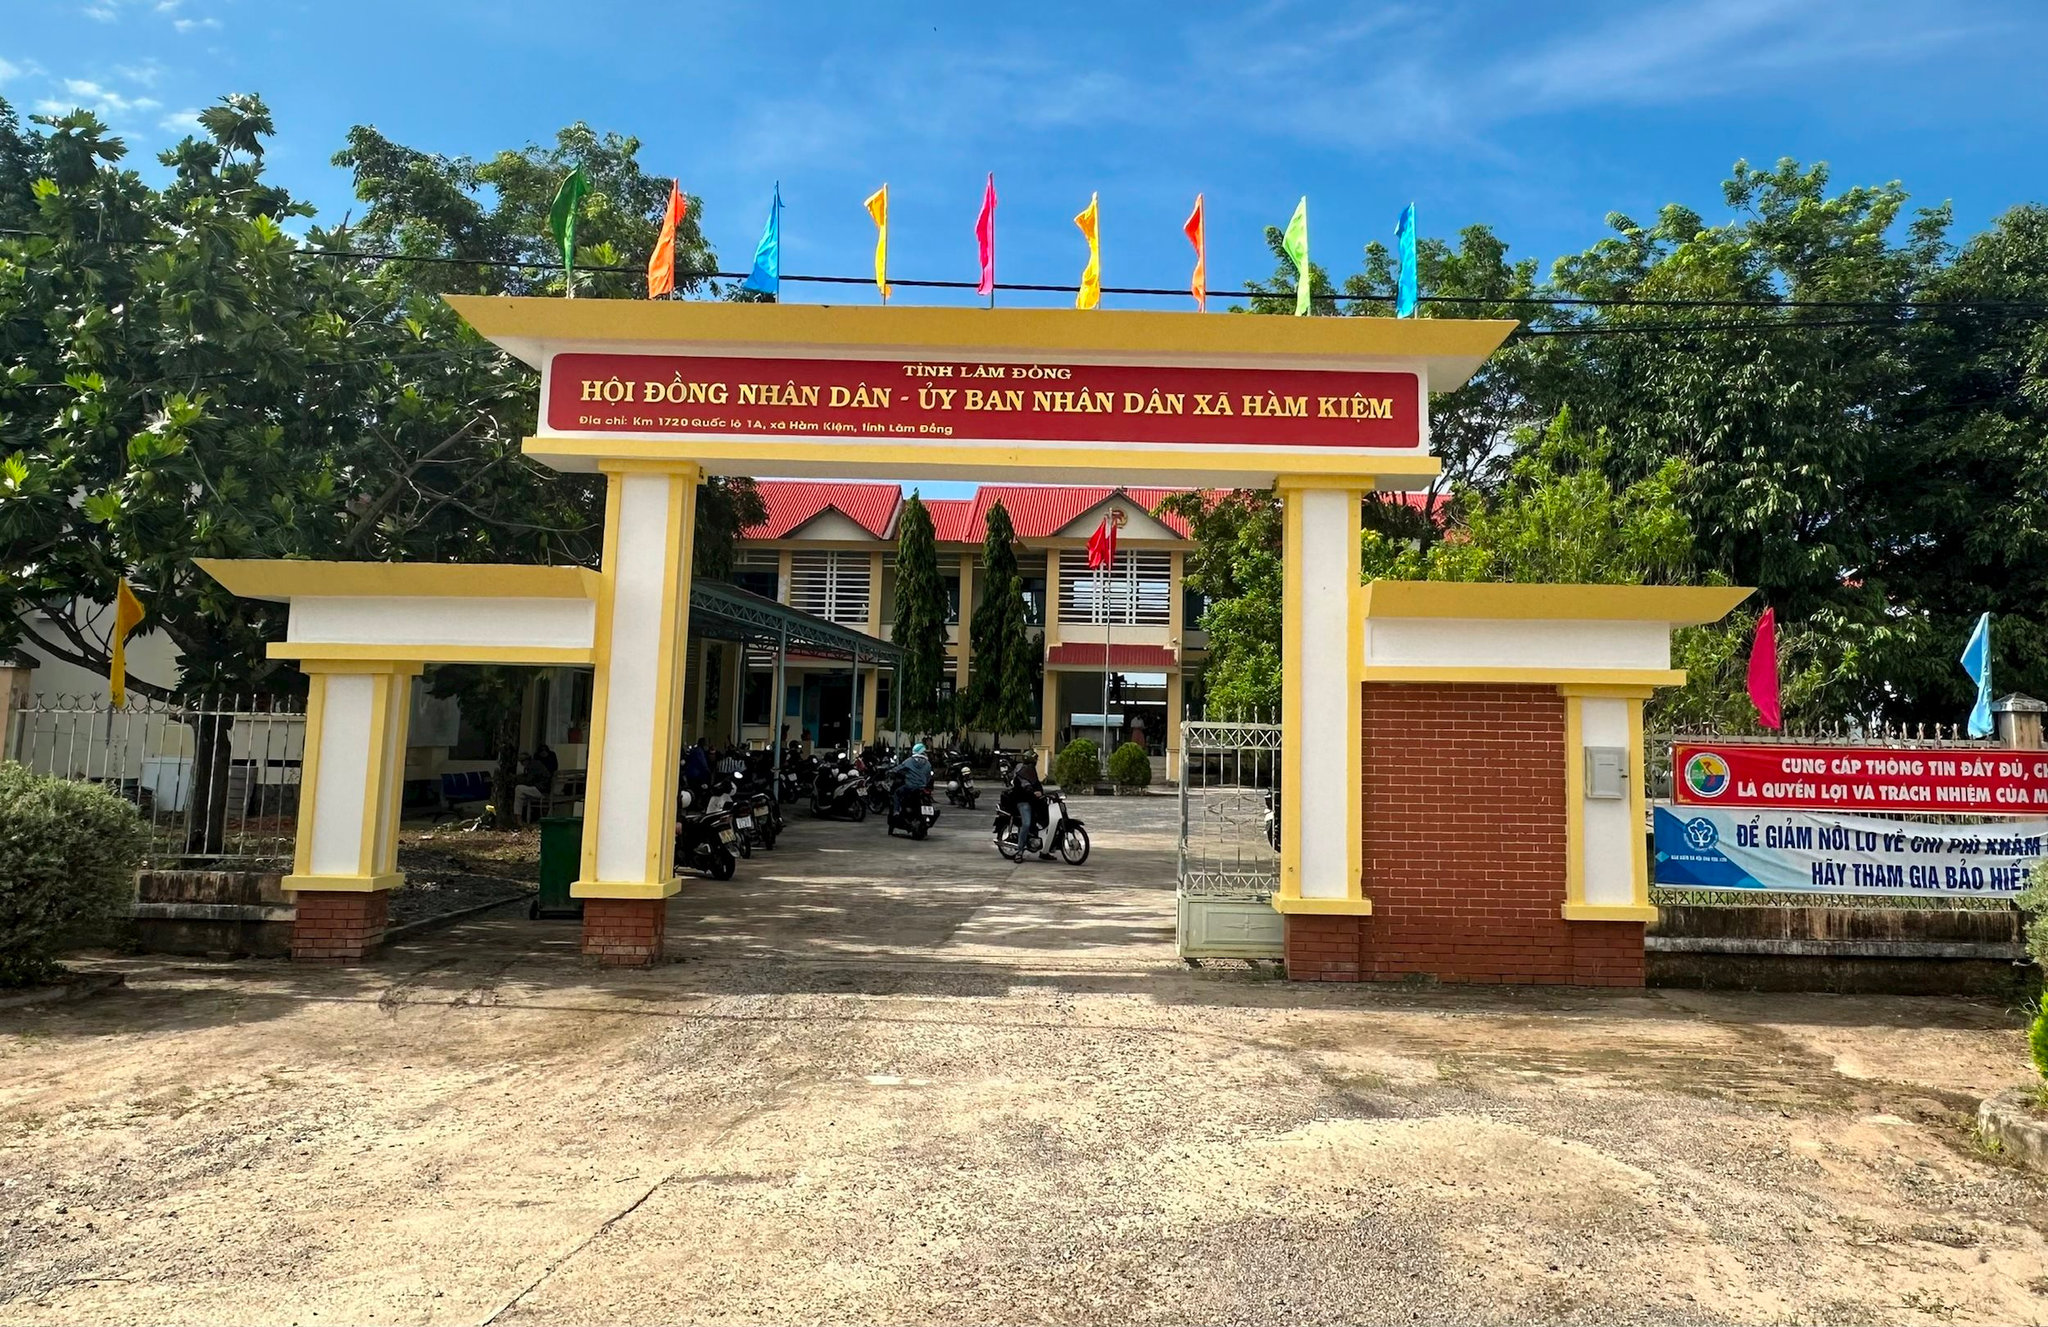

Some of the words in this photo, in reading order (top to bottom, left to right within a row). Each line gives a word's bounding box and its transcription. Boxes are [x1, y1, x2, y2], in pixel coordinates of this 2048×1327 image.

[960, 365, 1005, 378] LÂM
[580, 375, 635, 406] HỘI
[643, 371, 729, 404] ĐỒNG
[738, 380, 820, 406] NHÂN
[829, 382, 892, 408] DÂN
[918, 382, 957, 410] ỦY
[964, 389, 1025, 411] BAN
[1033, 386, 1115, 413] NHÂN
[1123, 388, 1185, 414] DÂN
[1193, 392, 1234, 416] XÃ
[1241, 390, 1308, 417] HÀM
[1317, 392, 1394, 422] KIỆM
[633, 416, 653, 426] Km
[658, 417, 689, 427] 1720
[691, 416, 726, 428] Quốc
[789, 420, 819, 430] Hàm
[1781, 757, 1827, 774] CUNG
[1831, 754, 1862, 775] CẤP
[1866, 757, 1924, 776] THÔNG
[1928, 760, 1956, 776] TIN
[1960, 756, 1994, 777] ĐẦY
[1737, 777, 1757, 797] LÀ
[1821, 783, 1848, 803] LỢI
[1852, 781, 1875, 800] VÀ
[1879, 782, 1931, 802] TRÁCH
[1936, 784, 1991, 806] NHIỆM
[1995, 783, 2030, 803] CỦA
[1736, 814, 1760, 848] ĐỂ
[1766, 817, 1812, 849] GIẢM
[1818, 821, 1850, 851] NỖI
[1812, 858, 1847, 887] HÃY
[1852, 863, 1904, 888] THAM
[1909, 865, 1941, 890] GIA
[1945, 858, 1984, 890] BẢO
